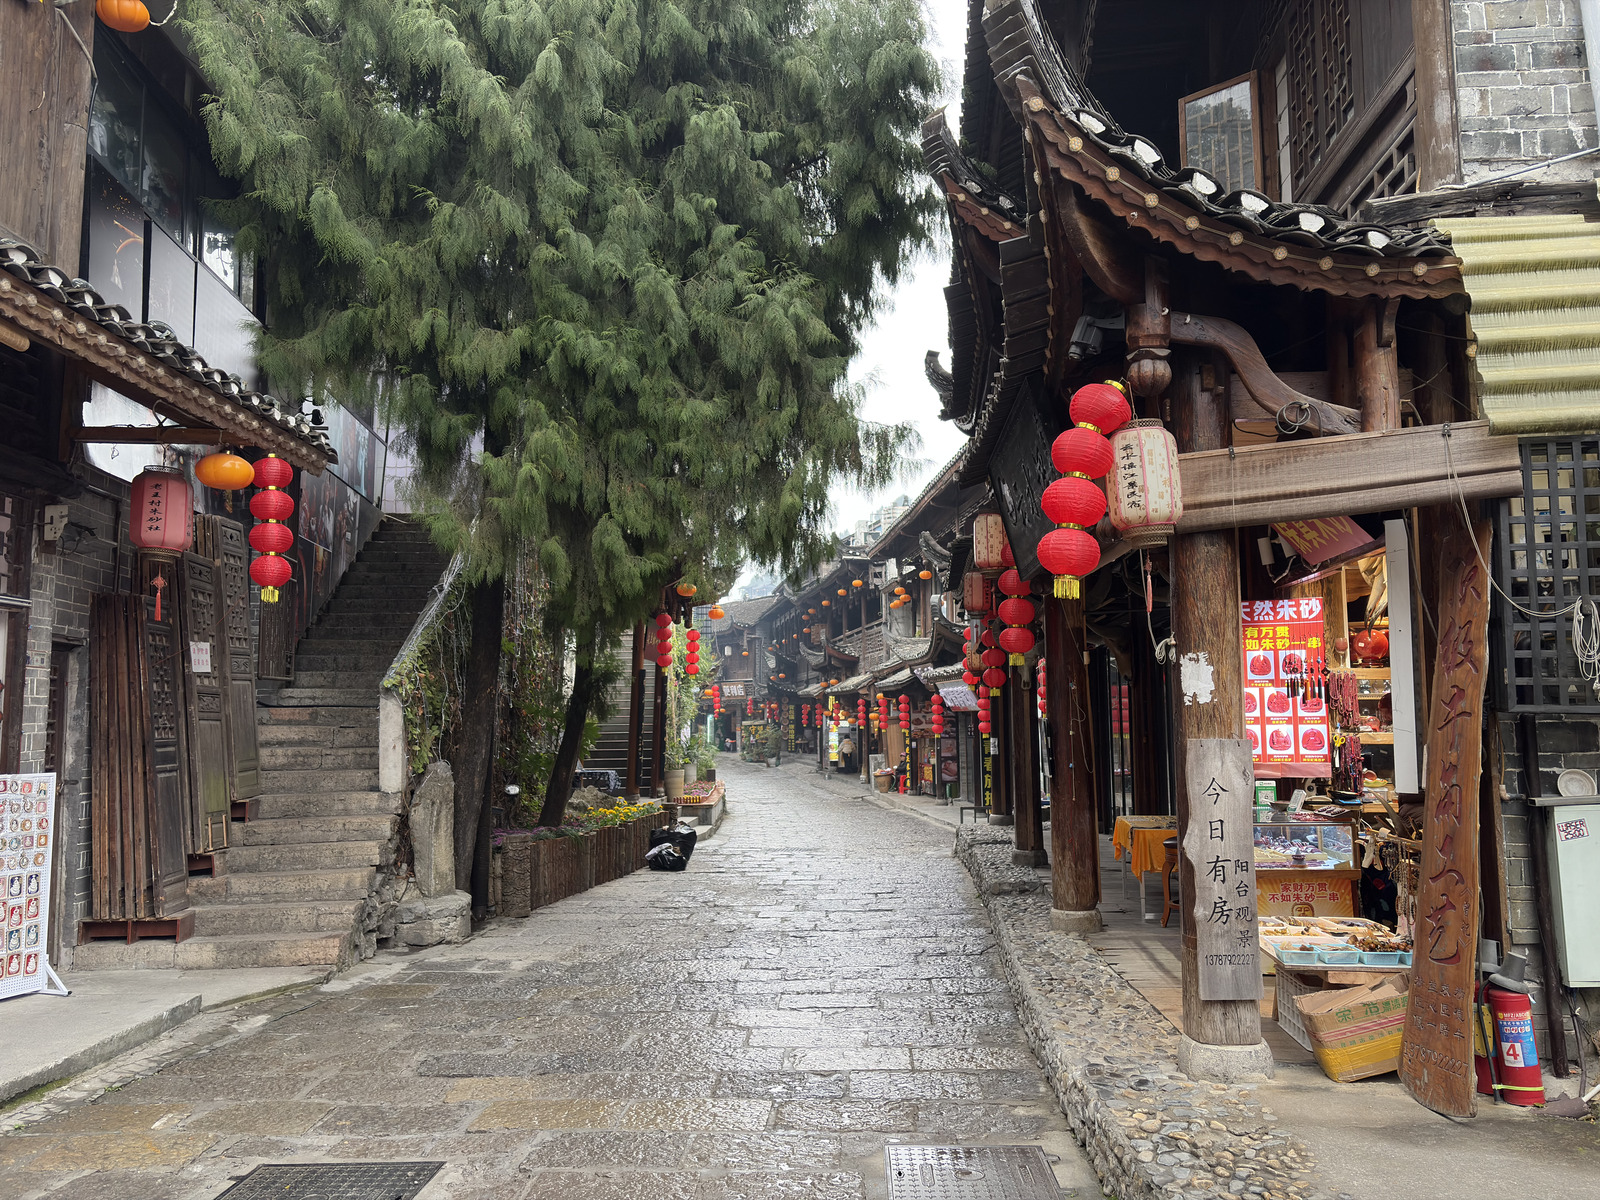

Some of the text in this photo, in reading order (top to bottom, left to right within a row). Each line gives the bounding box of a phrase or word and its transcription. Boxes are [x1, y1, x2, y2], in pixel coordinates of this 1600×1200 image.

[1242, 626, 1290, 638] 有万贯
[1242, 637, 1322, 650] 如朱砂一串
[722, 685, 745, 697] 便利店
[1201, 777, 1234, 926] 今日有房
[1280, 882, 1328, 893] 家财万贯
[1234, 859, 1253, 948] 阳台观景
[1268, 892, 1340, 903] 不如朱砂一串
[1204, 953, 1255, 967] 13787922227
[1506, 1043, 1520, 1061] 4
